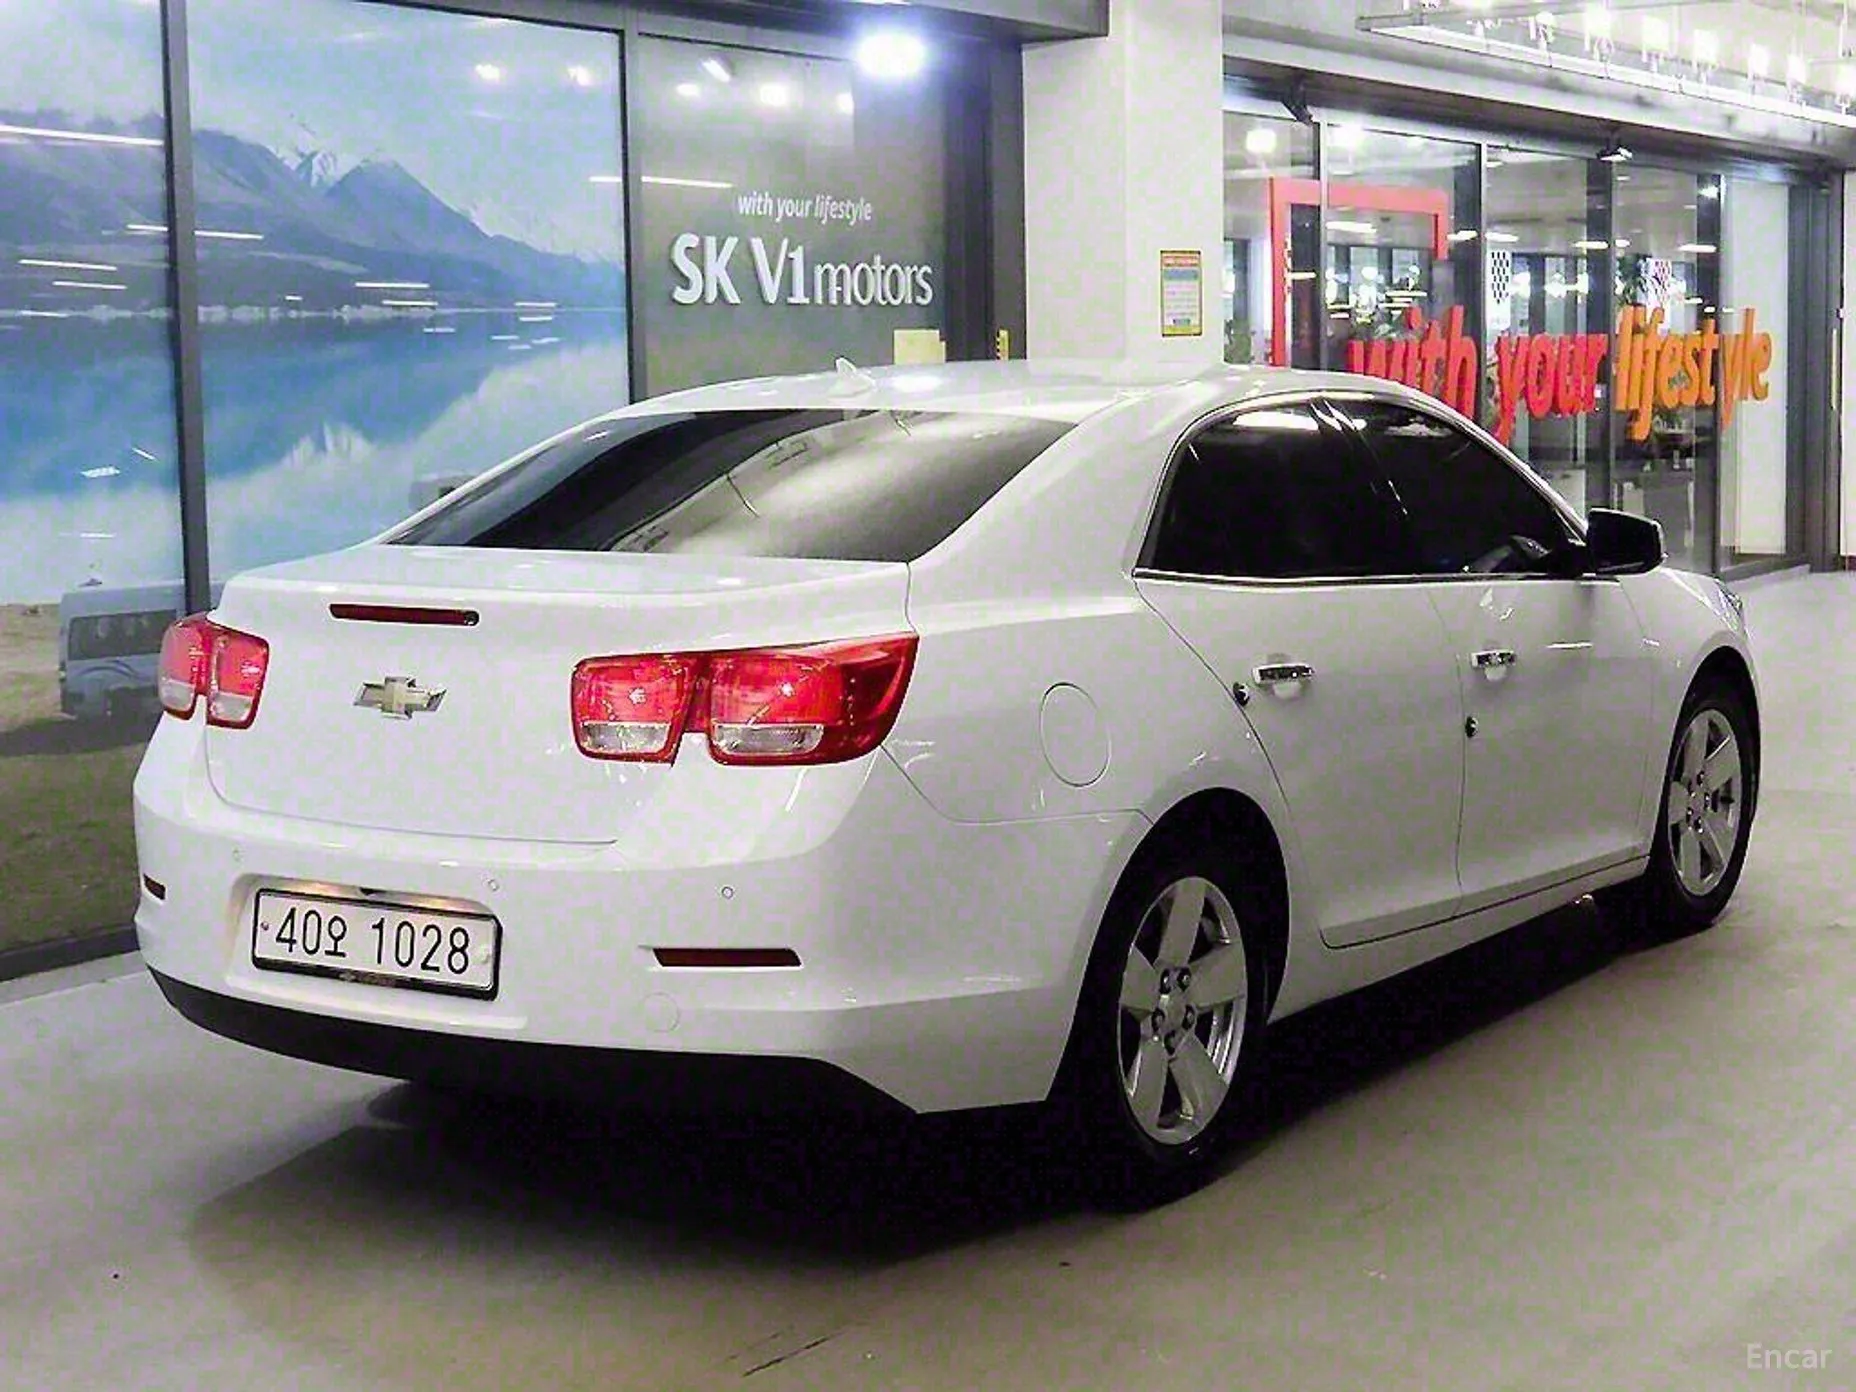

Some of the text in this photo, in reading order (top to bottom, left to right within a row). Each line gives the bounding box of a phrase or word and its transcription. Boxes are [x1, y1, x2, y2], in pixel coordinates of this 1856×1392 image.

[738, 191, 873, 226] with your lifestyle
[671, 233, 934, 306] SK V1 motors
[1494, 331, 1608, 447] your
[1614, 304, 1772, 443] lifestyle
[275, 907, 470, 975] 40오 1028
